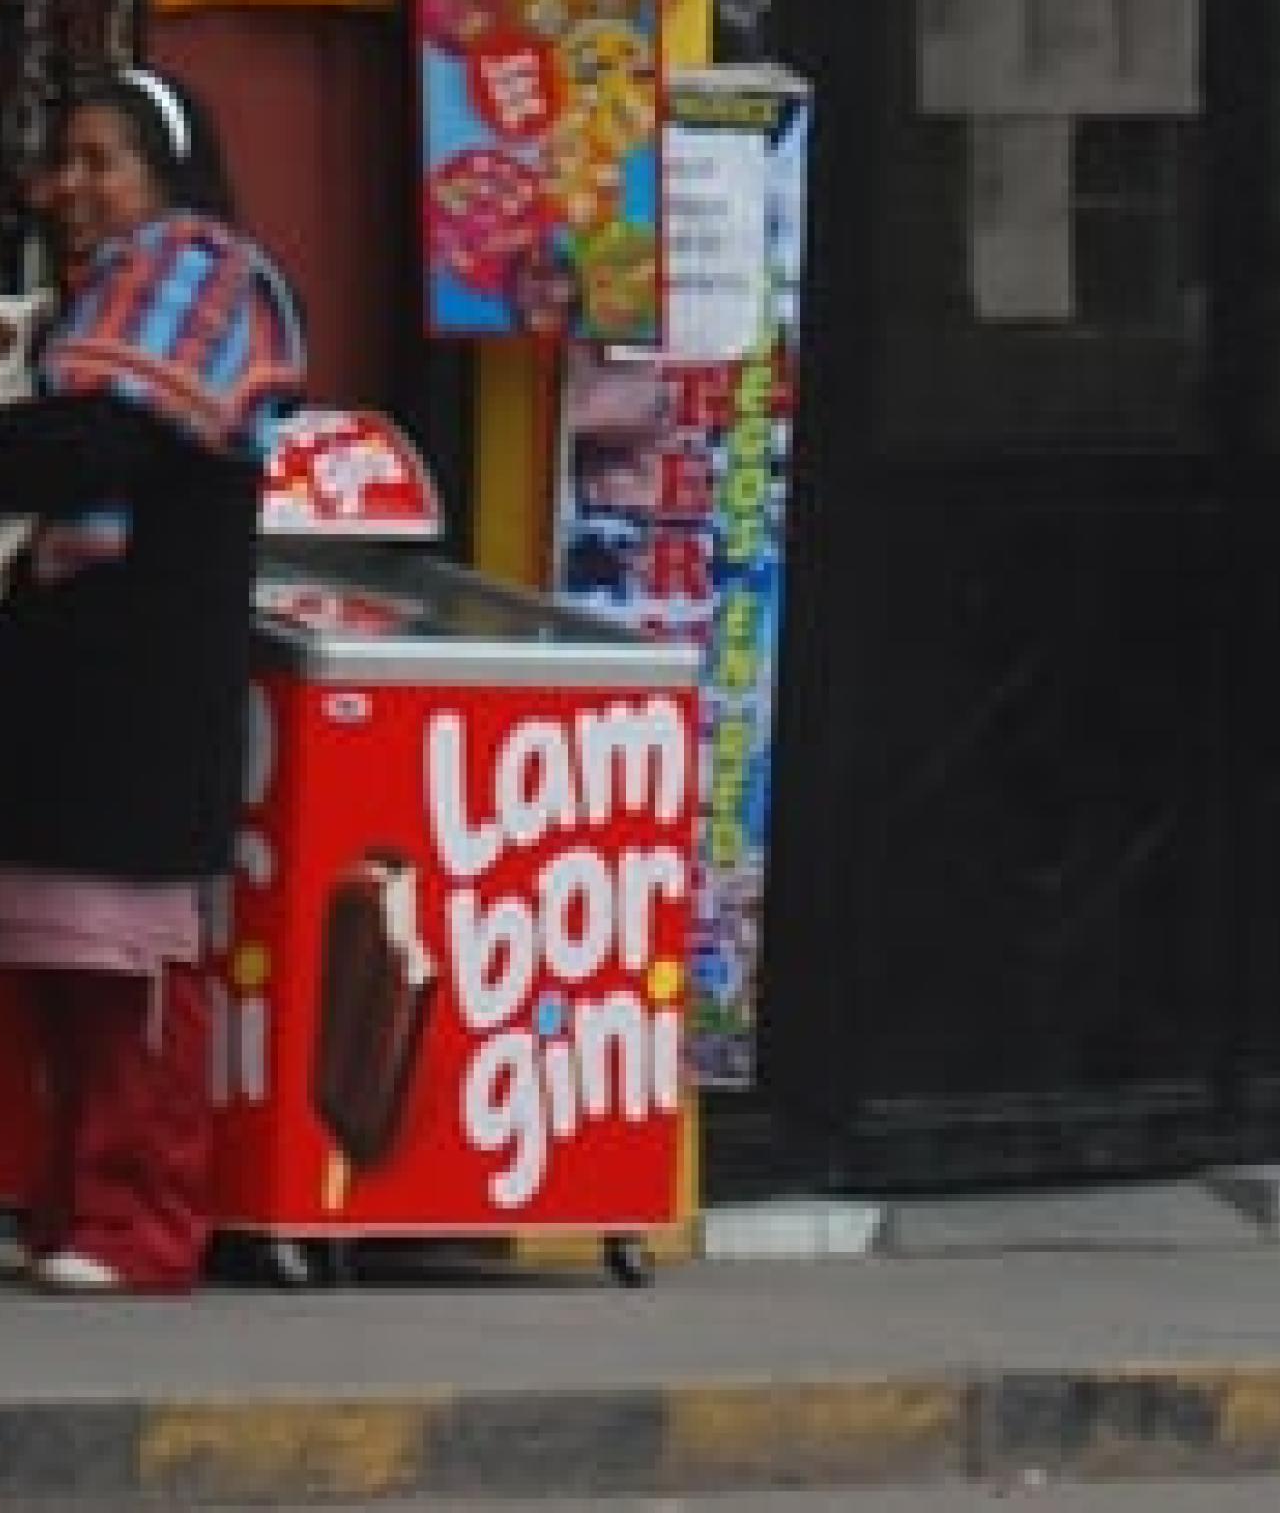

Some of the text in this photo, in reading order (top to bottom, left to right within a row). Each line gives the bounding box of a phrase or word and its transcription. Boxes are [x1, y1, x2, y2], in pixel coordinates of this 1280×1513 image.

[423, 694, 687, 878] Lam
[448, 847, 685, 1030] bor
[460, 959, 682, 1210] gini
